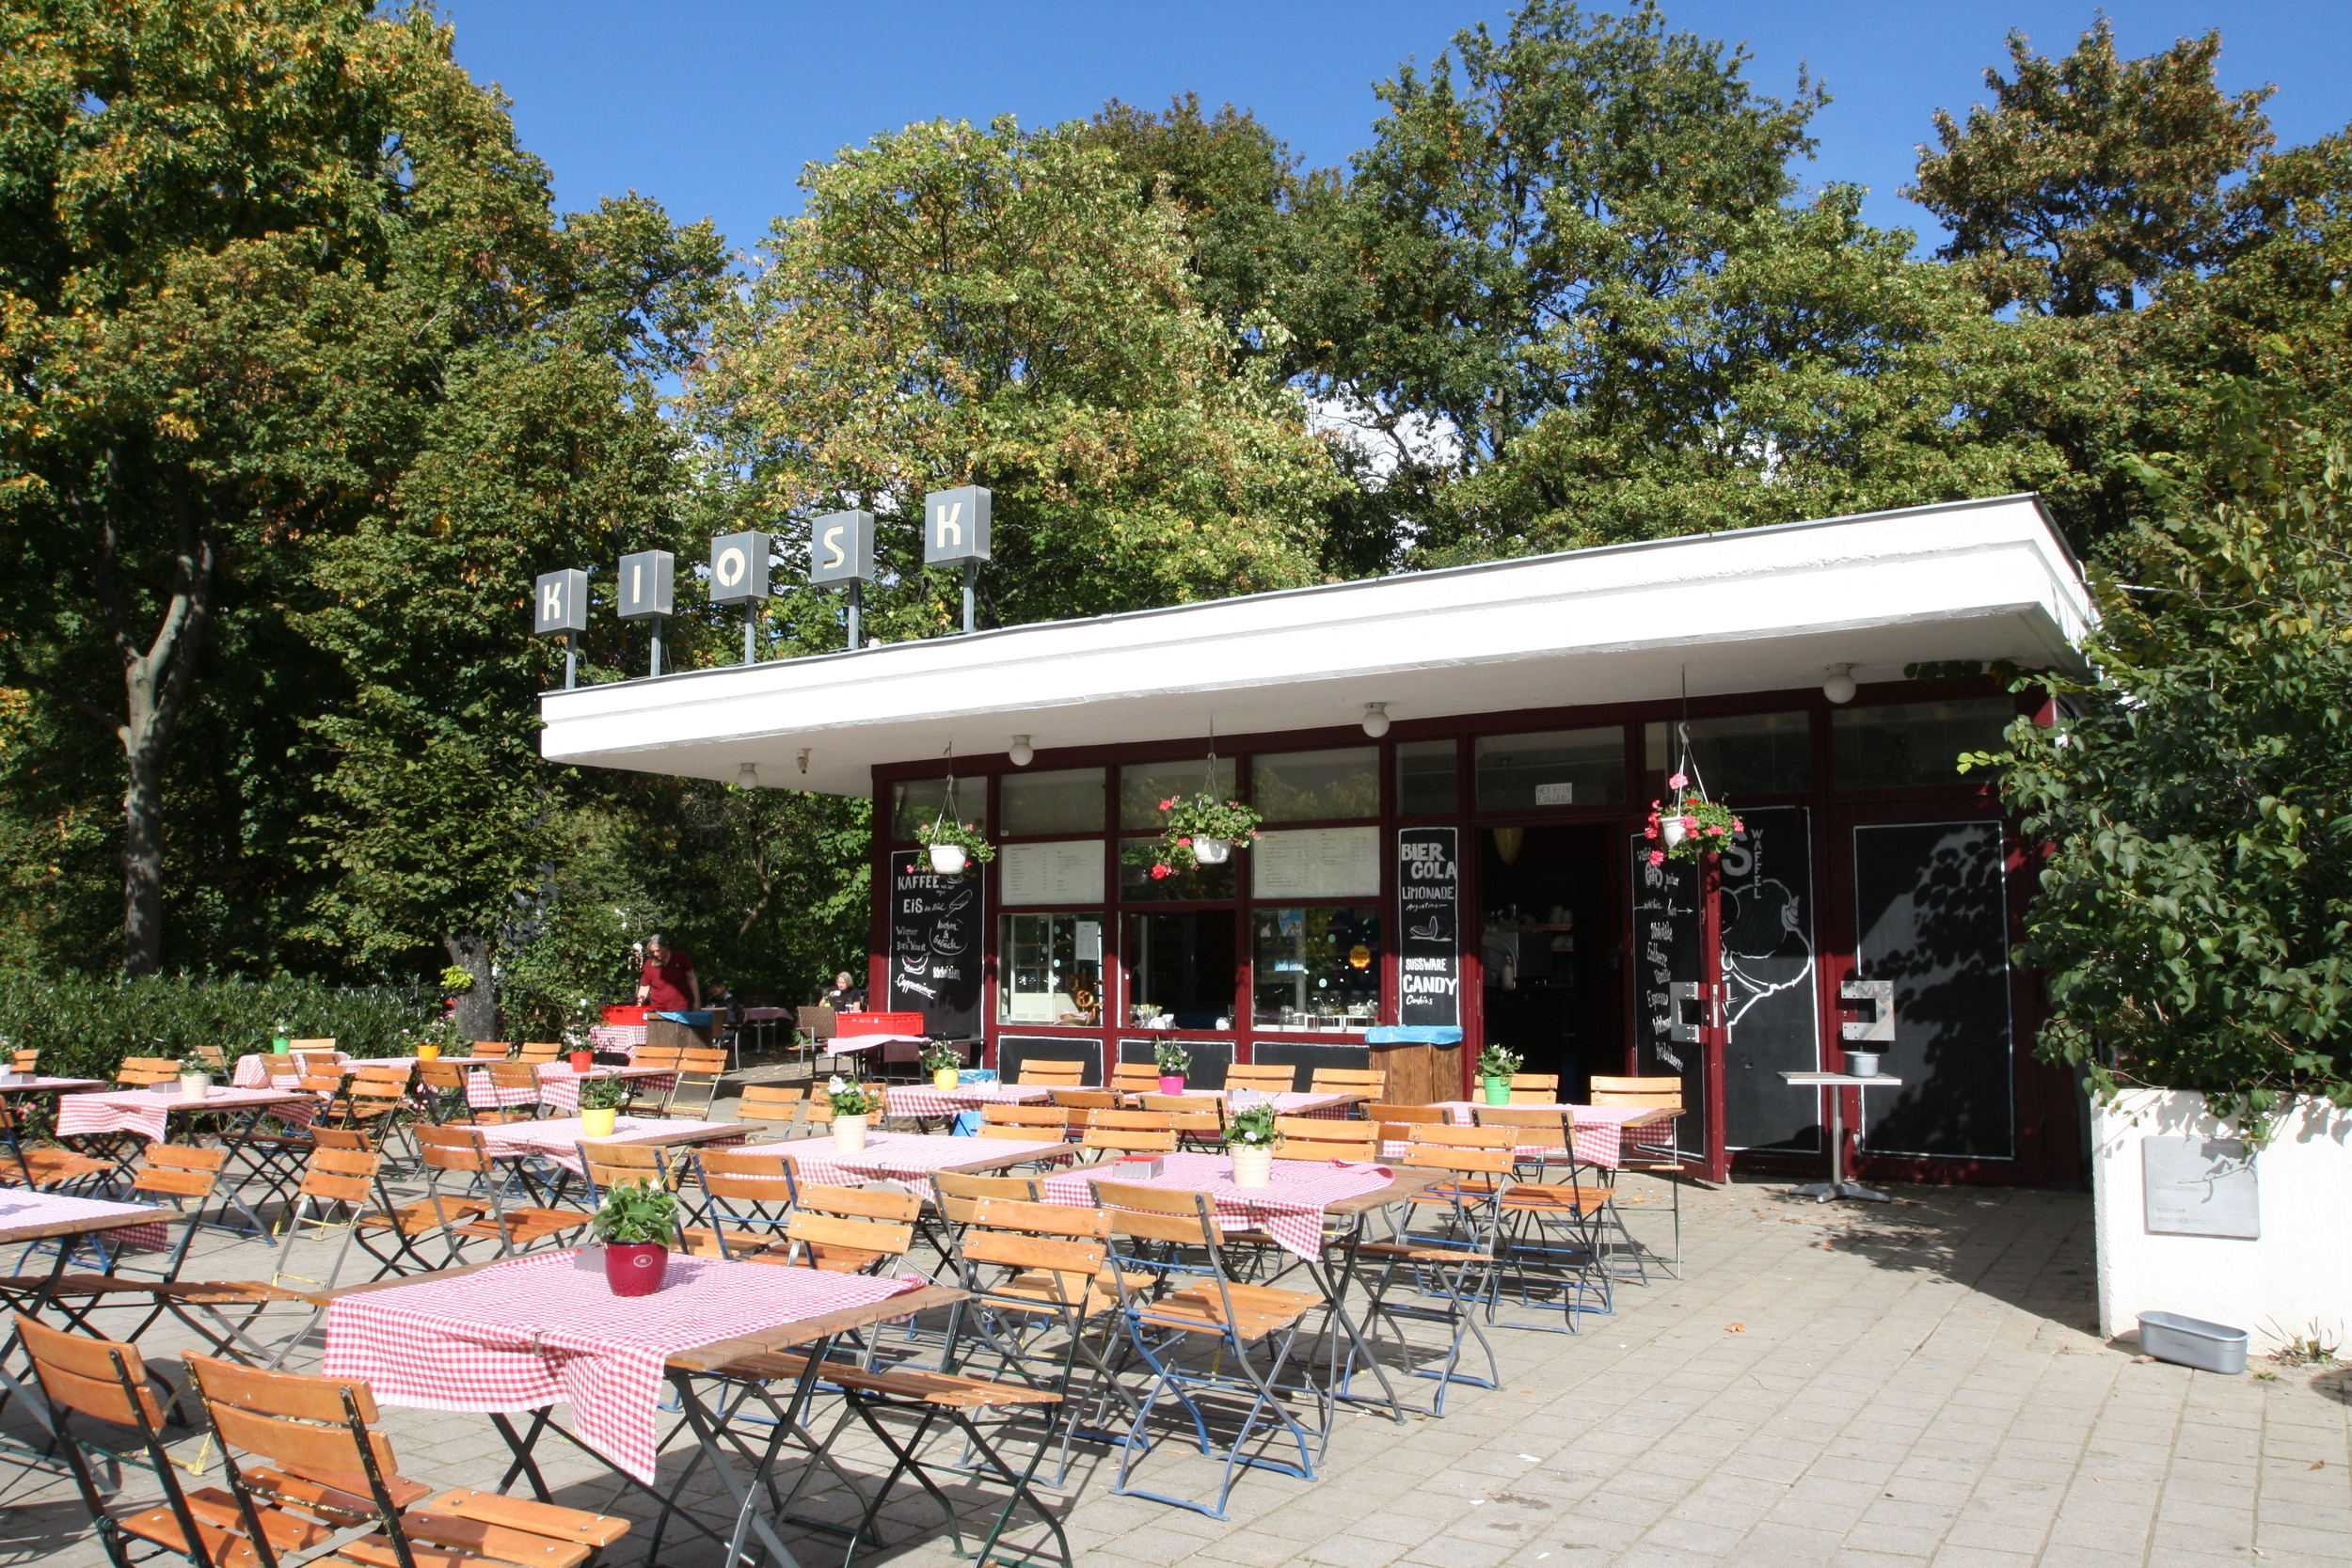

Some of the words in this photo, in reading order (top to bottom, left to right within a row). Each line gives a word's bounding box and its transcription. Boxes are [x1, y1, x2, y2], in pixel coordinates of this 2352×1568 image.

[543, 500, 962, 622] KIOSK
[1536, 786, 1551, 795] HIER
[1552, 785, 1571, 794] KEIN
[1537, 794, 1571, 804] EINGANG
[1410, 861, 1457, 879] COLA
[1751, 829, 1765, 899] WAFFEL
[898, 875, 940, 891] KAFFEE
[896, 926, 918, 935] Wiener
[1403, 974, 1457, 996] CANDY
[1406, 995, 1433, 1006] Cookies
